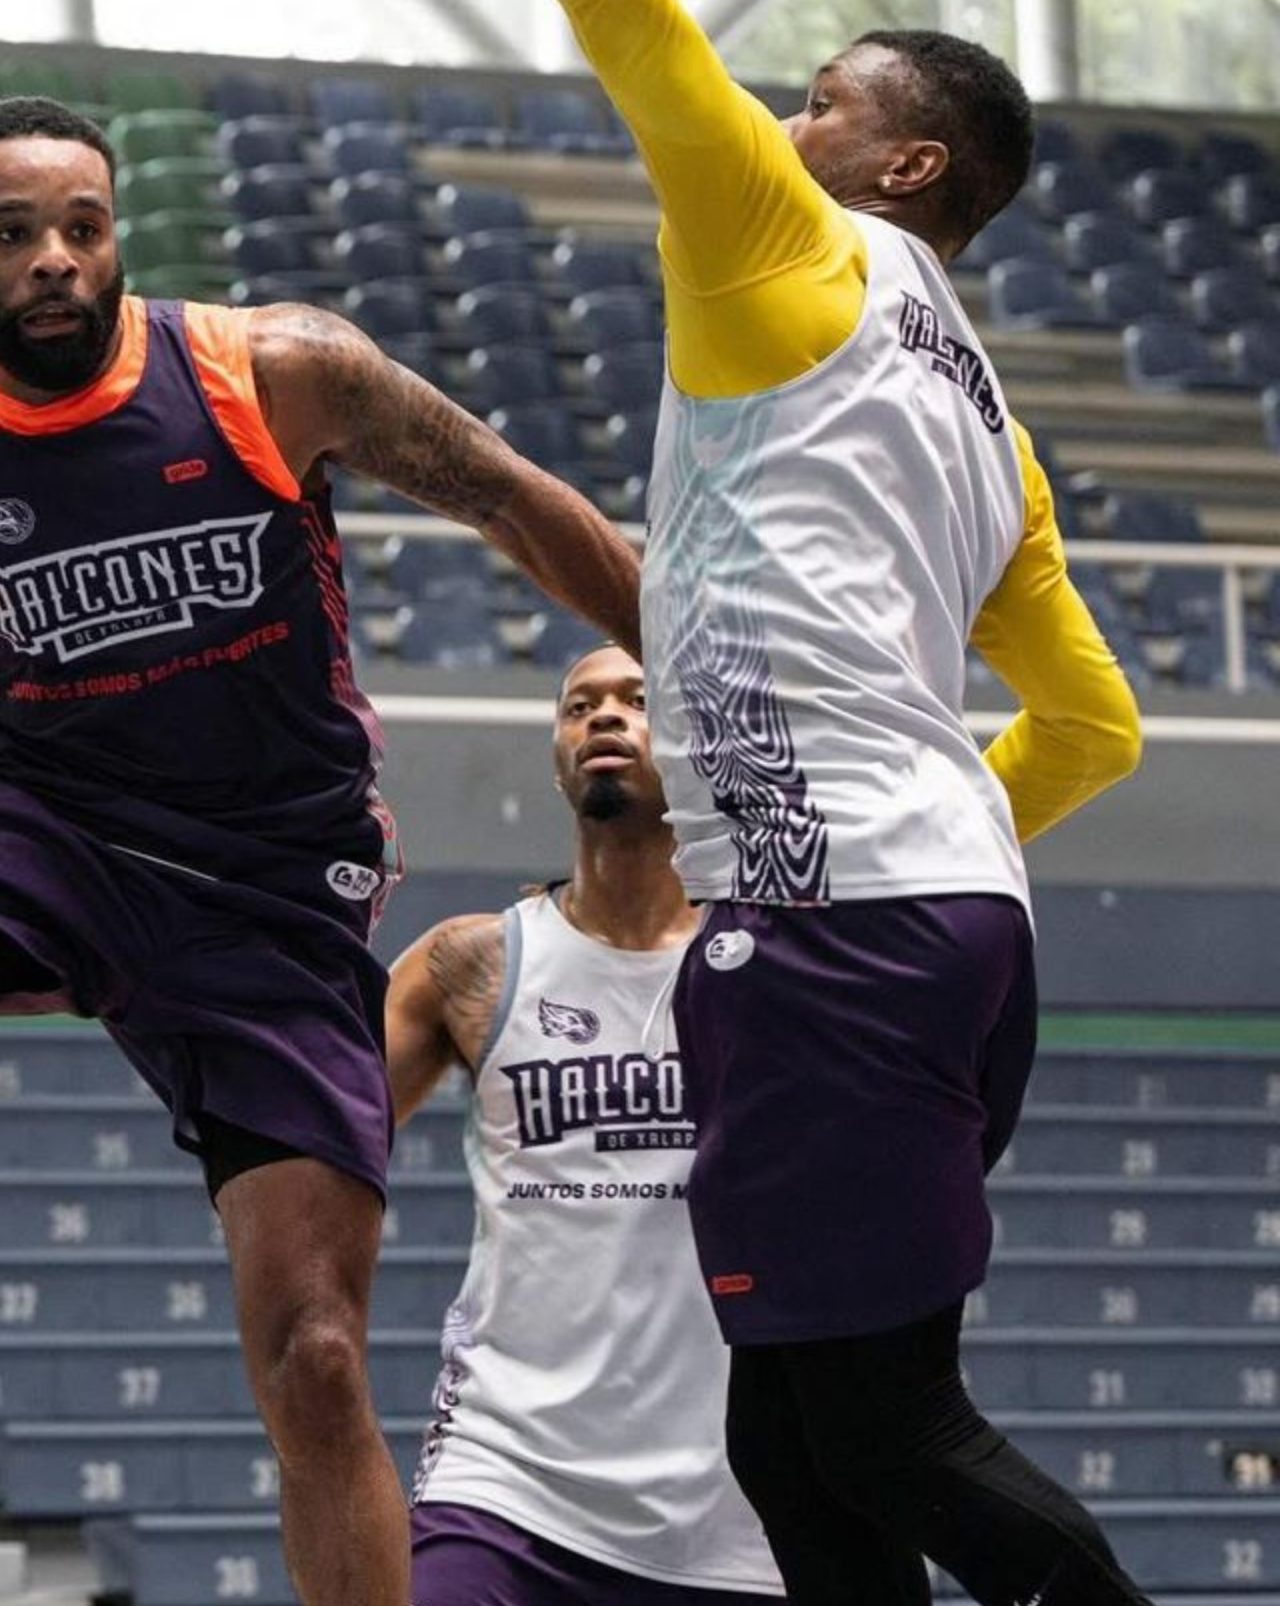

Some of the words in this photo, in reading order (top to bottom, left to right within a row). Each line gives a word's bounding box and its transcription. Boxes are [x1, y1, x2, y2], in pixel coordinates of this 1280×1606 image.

[900, 291, 1004, 432] HALNES
[75, 631, 93, 646] DE
[75, 672, 142, 698] SOMOS
[512, 1056, 684, 1144] HALCO
[608, 1131, 627, 1148] DE
[637, 1131, 697, 1147] XALAP
[507, 1183, 585, 1200] JUNTOS
[591, 1183, 667, 1200] SOMOS
